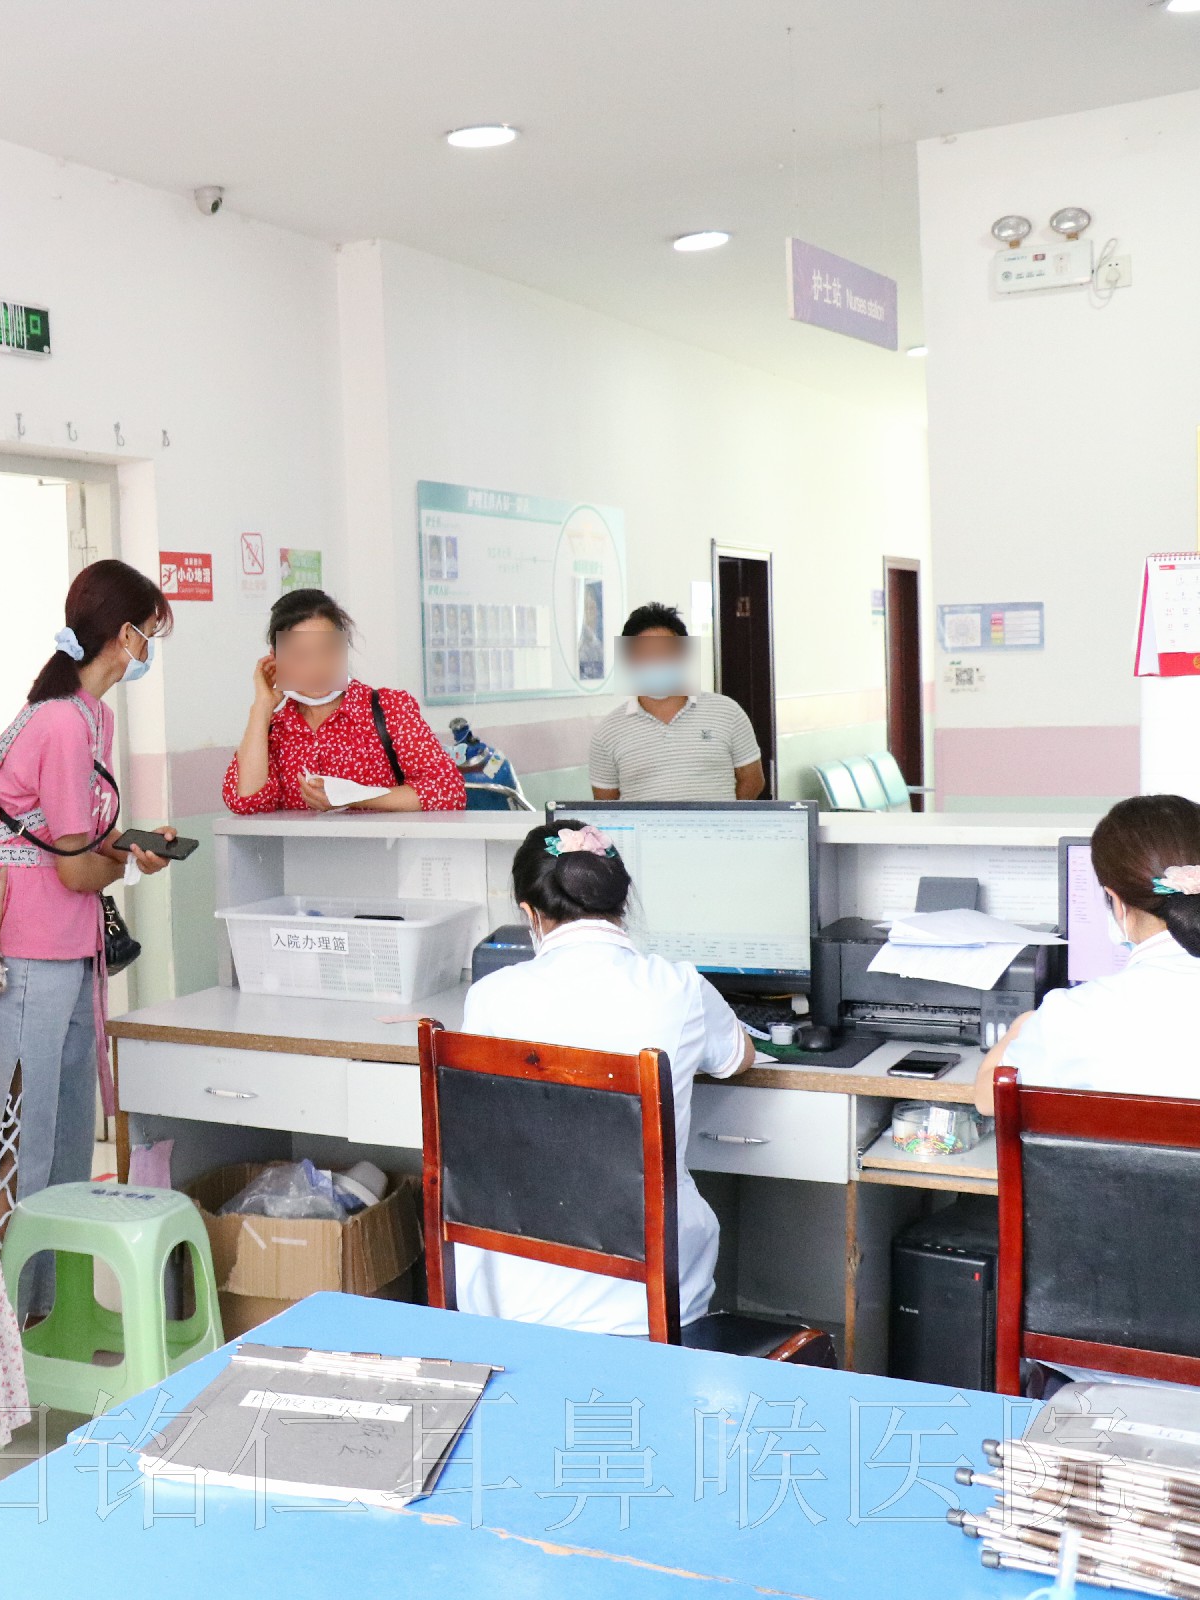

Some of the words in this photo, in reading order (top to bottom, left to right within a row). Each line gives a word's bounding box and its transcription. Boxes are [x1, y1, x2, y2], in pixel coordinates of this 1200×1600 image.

[811, 268, 842, 309] 护士站
[177, 567, 211, 583] 小心地滑
[273, 933, 347, 952] 入院办理篮
